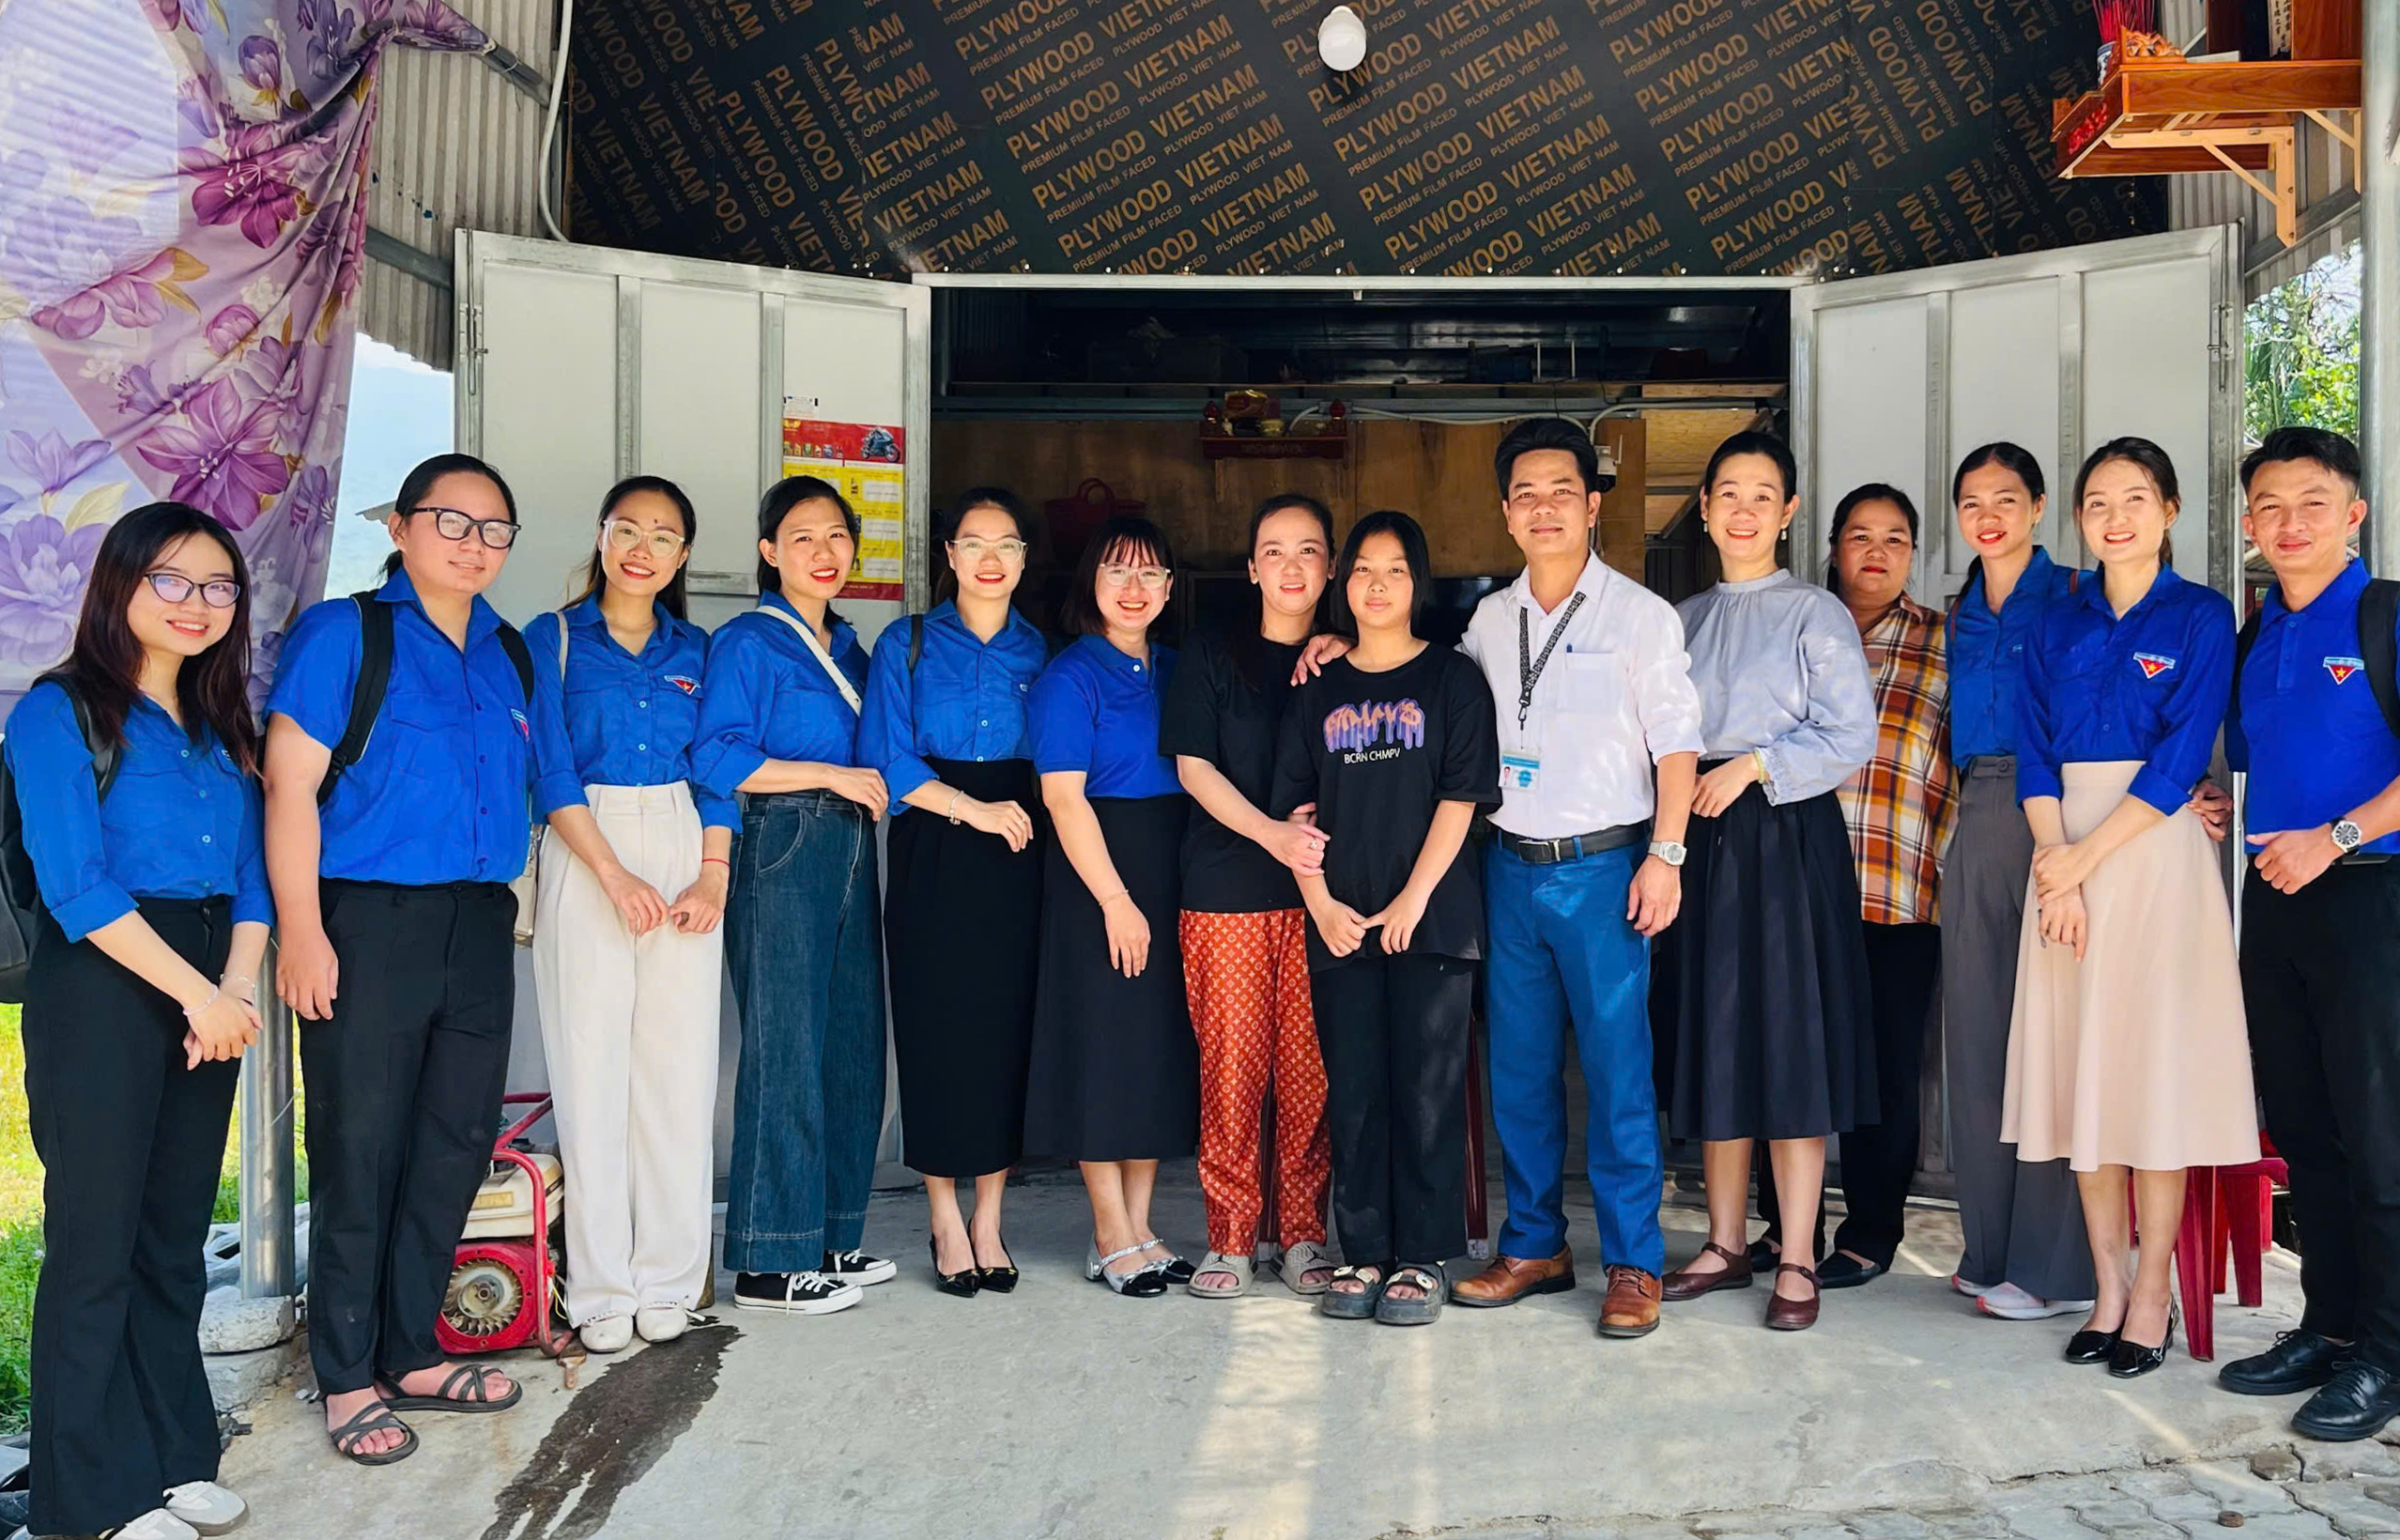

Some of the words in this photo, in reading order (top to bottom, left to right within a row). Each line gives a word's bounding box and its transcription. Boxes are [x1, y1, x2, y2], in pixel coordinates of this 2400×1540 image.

[720, 23, 738, 49] NAM
[889, 39, 914, 58] NAM
[971, 43, 1017, 75] PREMIUM
[1019, 28, 1043, 47] FILM
[1045, 8, 1078, 31] FACED
[1373, 9, 1406, 33] FACED
[1623, 47, 1669, 77] PREMIUM
[1672, 30, 1698, 49] FILM
[1700, 9, 1732, 34] FACED
[1893, 17, 1915, 51] FACED
[1962, 26, 1979, 51] FILM
[801, 54, 832, 101] PREMIUM
[828, 103, 847, 129] FILM
[982, 32, 1093, 108] PLYWOOD
[996, 92, 1042, 124] PREMIUM
[1044, 77, 1069, 96] FILM
[1070, 57, 1104, 81] FACED
[1114, 23, 1162, 56] PLYWOOD
[1165, 7, 1188, 24] VIET
[1008, 82, 1119, 158] PLYWOOD
[1125, 15, 1232, 86] VIETNAM
[1309, 34, 1422, 111] PLYWOOD
[1322, 95, 1370, 127] PREMIUM
[1372, 79, 1396, 98] FILM
[1397, 59, 1431, 83] FACED
[1440, 24, 1489, 57] PLYWOOD
[1493, 8, 1515, 26] VIET
[1335, 84, 1446, 160] PLYWOOD
[1452, 17, 1559, 88] VIETNAM
[1636, 35, 1747, 110] PLYWOOD
[1650, 95, 1697, 126] PREMIUM
[1699, 80, 1723, 99] FILM
[1725, 60, 1758, 83] FACED
[1767, 25, 1816, 58] PLYWOOD
[1820, 8, 1842, 26] VIET
[1864, 79, 1883, 103] FILM
[1869, 27, 1942, 141] PLYWOOD
[1913, 53, 1931, 77] FILM
[1917, 1, 1991, 115] PLYWOOD
[768, 67, 843, 180] PLYWOOD
[889, 103, 912, 121] VIET
[915, 88, 939, 107] NAM
[1022, 143, 1068, 173] PREMIUM
[1070, 126, 1095, 146] FILM
[1097, 106, 1130, 130] FACED
[1138, 73, 1188, 105] PLYWOOD
[1191, 56, 1213, 74] VIET
[1218, 41, 1241, 60] NAM
[1033, 131, 1145, 208] PLYWOOD
[1151, 65, 1258, 136] VIETNAM
[1348, 144, 1395, 176] PREMIUM
[1397, 129, 1422, 147] FILM
[1423, 108, 1456, 131] FACED
[1465, 74, 1515, 107] PLYWOOD
[1517, 57, 1540, 75] VIET
[1544, 42, 1568, 61] NAM
[1360, 133, 1471, 209] PLYWOOD
[1478, 66, 1585, 138] VIETNAM
[1661, 85, 1773, 160] PLYWOOD
[1675, 144, 1722, 177] PREMIUM
[1723, 129, 1747, 148] FILM
[1750, 108, 1784, 131] FACED
[1792, 74, 1842, 107] PLYWOOD
[1879, 105, 1908, 153] PREMIUM
[1927, 79, 1957, 126] PREMIUM
[639, 93, 709, 203] VIETNAM
[719, 92, 794, 207] PLYWOOD
[753, 80, 783, 128] PREMIUM
[780, 130, 798, 154] FILM
[795, 157, 819, 192] FACED
[819, 200, 852, 250] PLYWOOD
[859, 112, 956, 183] IETNAM
[915, 153, 937, 170] VIET
[942, 137, 965, 156] NAM
[1047, 192, 1094, 223] PREMIUM
[1096, 176, 1120, 195] FILM
[1122, 156, 1156, 178] FACED
[1164, 122, 1213, 155] PLYWOOD
[1217, 105, 1238, 123] VIET
[1243, 90, 1268, 109] NAM
[1374, 193, 1421, 224] PREMIUM
[1423, 177, 1447, 196] FILM
[1449, 158, 1482, 181] FACED
[1491, 124, 1540, 156] PLYWOOD
[1544, 107, 1566, 124] VIET
[1570, 91, 1593, 109] NAM
[1686, 132, 1798, 209] PLYWOOD
[1971, 158, 1990, 182] NAM
[732, 156, 750, 181] FILM
[747, 182, 770, 218] FACED
[874, 162, 982, 234] VIETNAM
[888, 219, 937, 251] PLYWOOD
[941, 202, 963, 220] VIET
[967, 187, 992, 205] NAM
[1059, 180, 1171, 255] PLYWOOD
[1177, 115, 1283, 186] VIETNAM
[1073, 240, 1120, 272] PREMIUM
[1122, 225, 1146, 244] FILM
[1148, 205, 1181, 229] FACED
[1190, 172, 1239, 205] PLYWOOD
[1242, 155, 1265, 173] VIET
[1269, 140, 1293, 159] NAM
[1202, 163, 1309, 235] VIETNAM
[1386, 182, 1497, 258] PLYWOOD
[1502, 115, 1609, 187] VIETNAM
[1448, 226, 1472, 246] FILM
[1474, 207, 1508, 231] FACED
[1516, 173, 1565, 206] PLYWOOD
[1568, 156, 1591, 174] VIET
[1594, 141, 1619, 159] NAM
[1529, 164, 1636, 236] VIETNAM
[1700, 193, 1746, 225] PREMIUM
[1748, 177, 1774, 197] FILM
[1776, 157, 1808, 180] FACED
[1713, 182, 1823, 258] PLYWOOD
[1922, 184, 1940, 208] NAM
[967, 251, 989, 270] VIET
[993, 237, 1018, 254] NAM
[1216, 222, 1265, 254] PLYWOOD
[1269, 205, 1290, 222] VIET
[1294, 190, 1318, 208] NAM
[1542, 222, 1591, 254] PLYWOOD
[1594, 205, 1616, 223] VIET
[1620, 190, 1644, 208] NAM
[1646, 239, 1669, 256] NAM
[1726, 242, 1773, 273] PREMIUM
[1775, 227, 1799, 245] FILM
[1801, 206, 1835, 229] FACED
[1874, 211, 1892, 235] NAM
[1888, 239, 1906, 261] VIET
[1937, 212, 1955, 235] VIET
